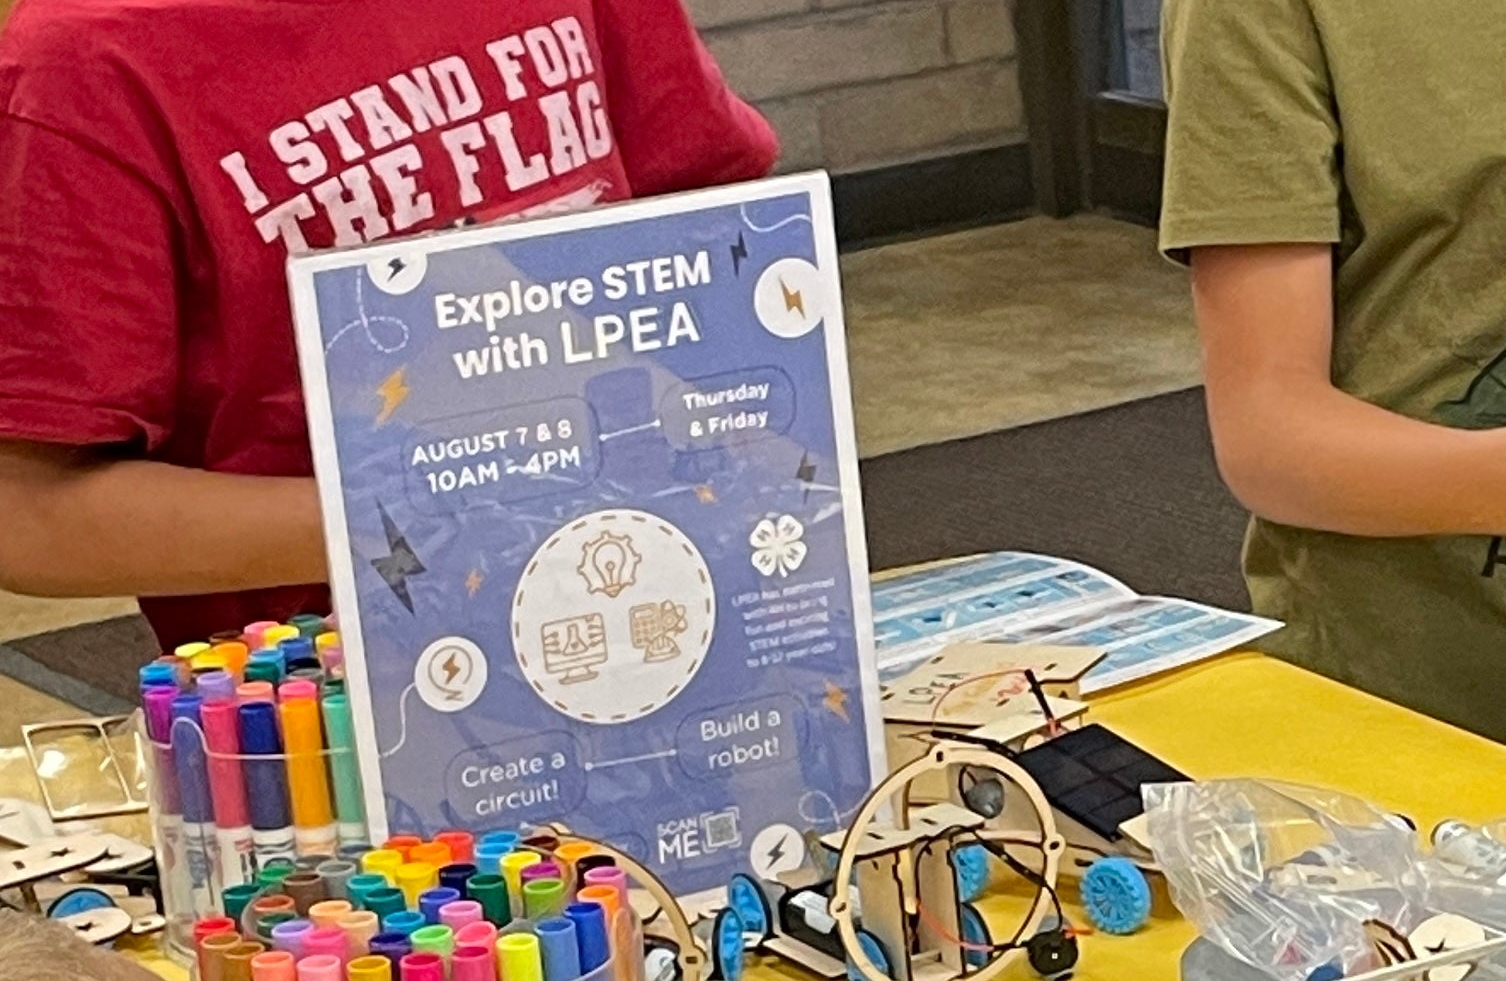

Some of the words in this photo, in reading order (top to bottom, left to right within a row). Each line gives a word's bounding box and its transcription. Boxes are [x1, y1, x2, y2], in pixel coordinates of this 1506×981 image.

[220, 151, 268, 213] I
[269, 56, 484, 185] STAND
[486, 16, 595, 101] FOR
[255, 144, 435, 254] THE
[440, 81, 612, 207] FLAG
[435, 279, 594, 332] Explore
[602, 250, 711, 300] STEM
[452, 332, 549, 379] with
[560, 302, 701, 364] LPEA
[683, 382, 769, 411] Thursday
[689, 421, 703, 437] &
[707, 410, 769, 436] Friday
[411, 429, 509, 466] AUGUST
[514, 425, 529, 446] 7
[536, 423, 552, 442] &
[557, 419, 573, 439] 8
[426, 460, 500, 495] 10AM
[524, 445, 581, 475] 4PM
[701, 710, 760, 741] Build
[768, 709, 781, 726] a
[461, 755, 544, 788] Create
[552, 751, 567, 769] a
[708, 736, 780, 770] robot!
[475, 779, 559, 816] circuit!
[656, 816, 699, 837] SCAN
[658, 830, 701, 864] ME
